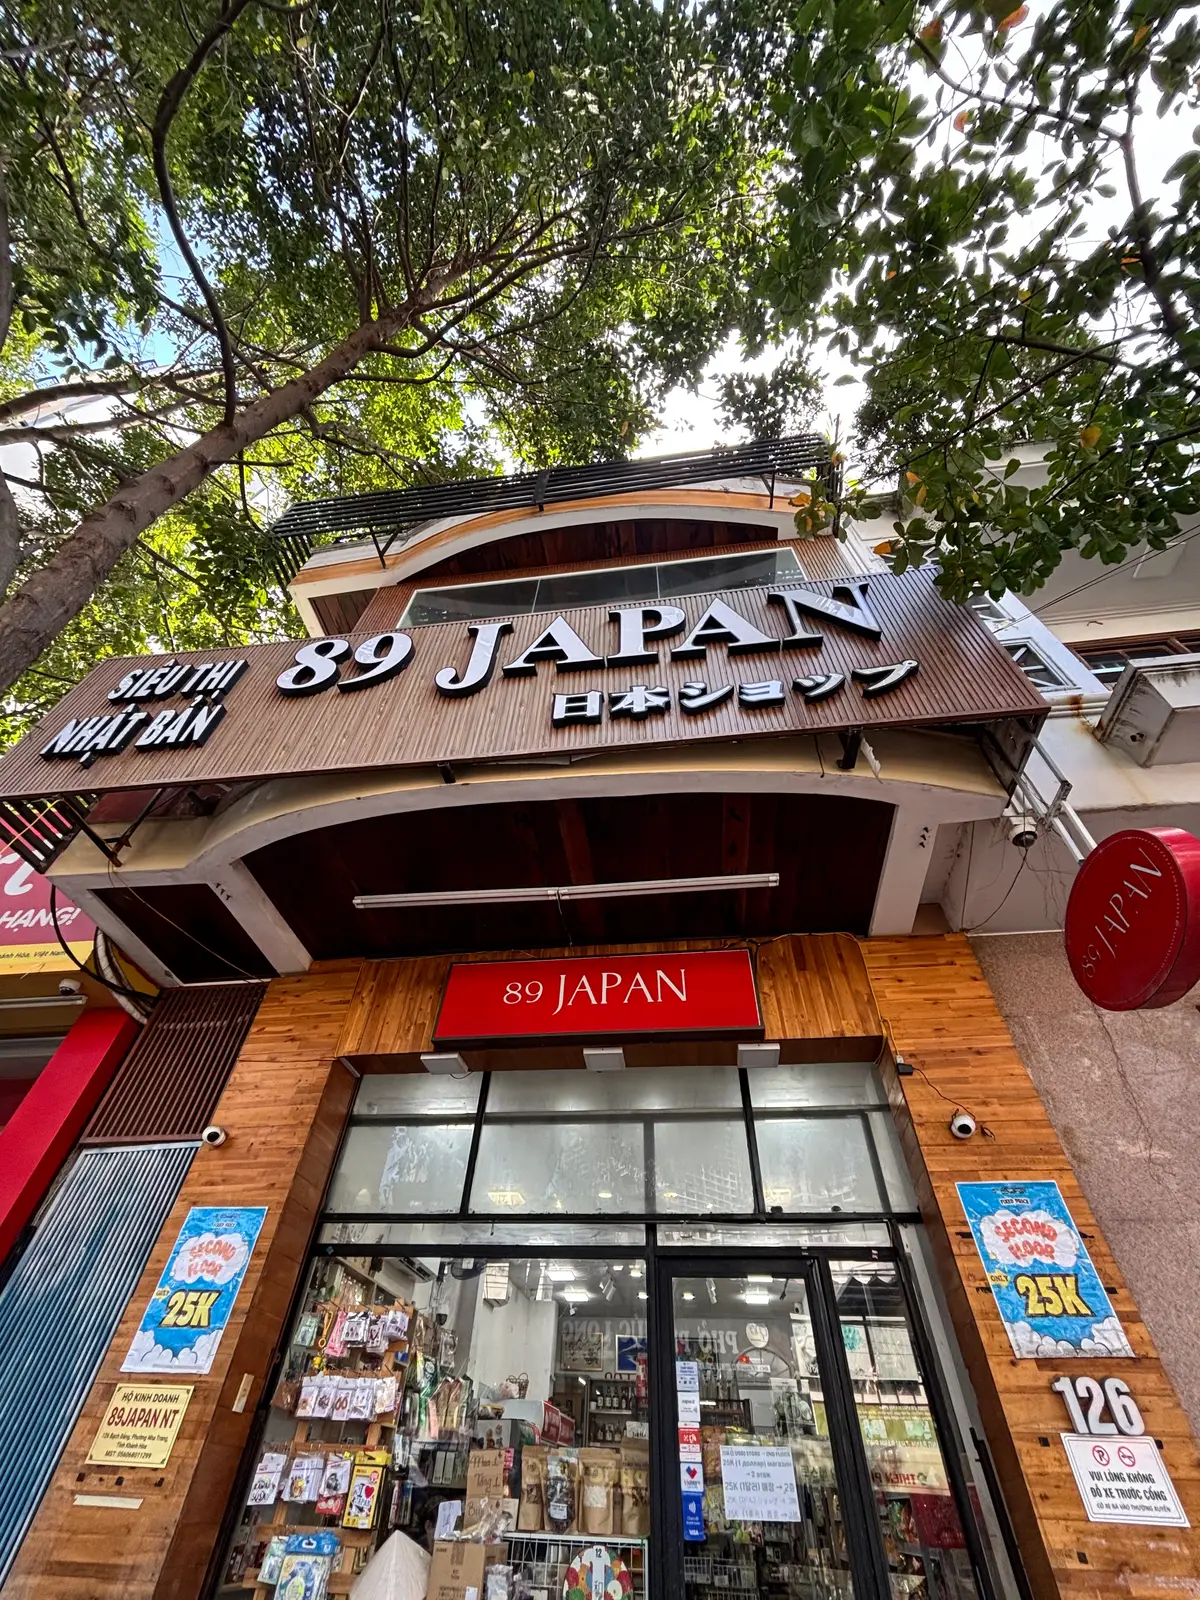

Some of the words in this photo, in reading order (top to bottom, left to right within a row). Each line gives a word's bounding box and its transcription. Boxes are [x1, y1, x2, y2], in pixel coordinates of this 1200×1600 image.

[275, 632, 414, 698] 89
[434, 582, 882, 697] JAPAN
[108, 658, 191, 704] SIÊU
[182, 659, 249, 702] THỊ
[552, 659, 919, 727] 日本ショップ
[40, 704, 153, 769] NHẬT
[135, 695, 227, 752] BẢN
[1095, 847, 1162, 959] JAPAN
[503, 981, 543, 1005] 89
[552, 968, 687, 1015] JAPAN
[994, 1217, 1058, 1243] SECOND
[189, 1240, 236, 1262] SECOND
[1008, 1240, 1055, 1260] FLOOR
[188, 1259, 223, 1278] FLOOR
[990, 1275, 1009, 1283] ONLY
[158, 1289, 222, 1328] 25K
[1014, 1273, 1096, 1317] 25K
[122, 1390, 134, 1403] HỘ
[134, 1392, 153, 1401] KINH
[152, 1393, 180, 1403] DOANH
[1052, 1376, 1145, 1436] 126
[107, 1407, 162, 1428] 89JAPAN
[160, 1409, 179, 1428] NT
[1088, 1471, 1102, 1482] VUI
[1103, 1469, 1126, 1483] LÒNG
[1126, 1470, 1156, 1485] KHÔNG
[1103, 1487, 1116, 1499] XE
[1115, 1486, 1143, 1500] TRƯỚC
